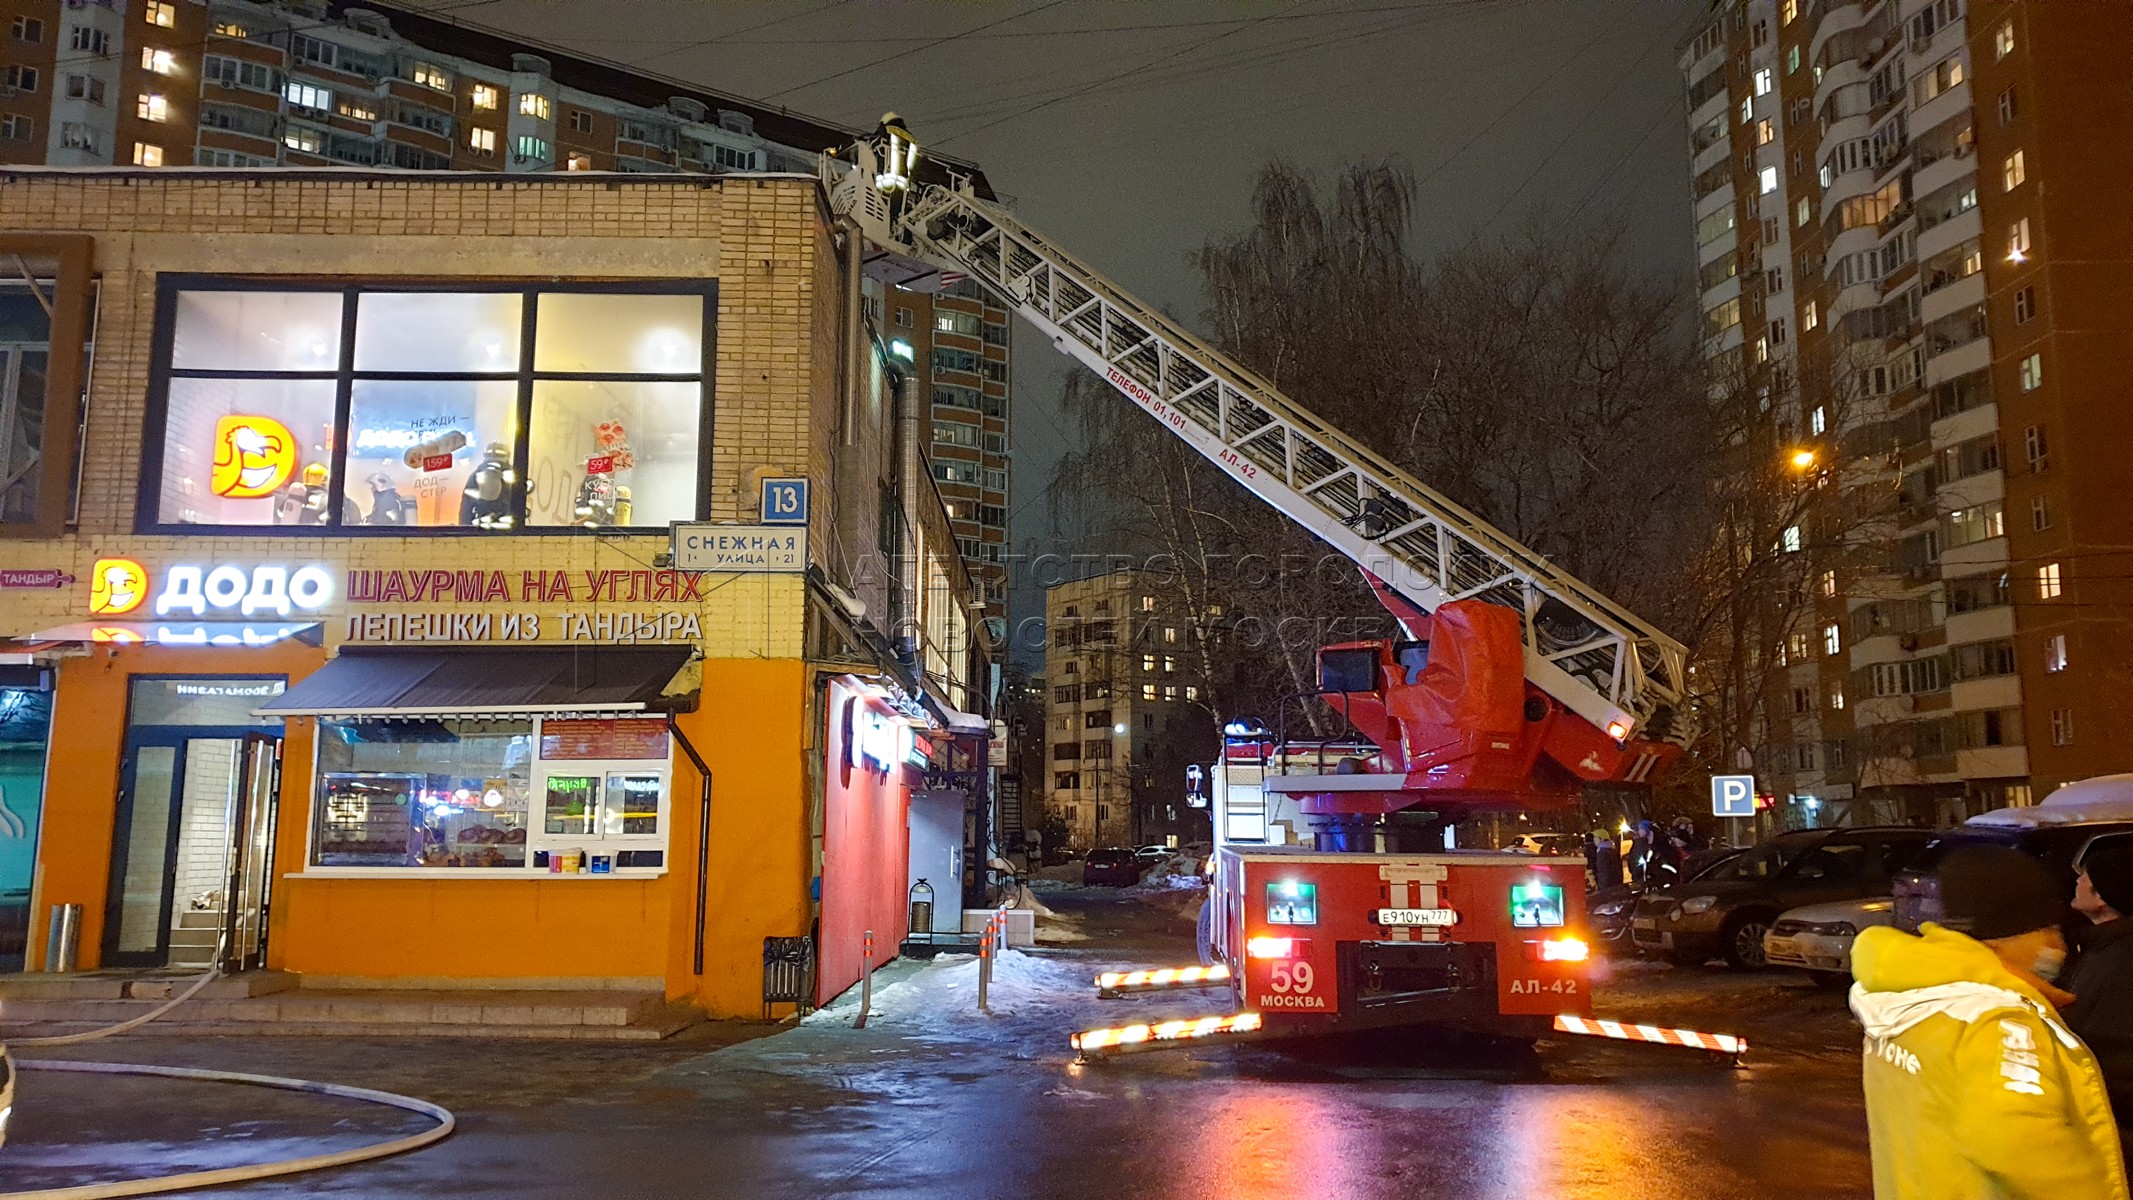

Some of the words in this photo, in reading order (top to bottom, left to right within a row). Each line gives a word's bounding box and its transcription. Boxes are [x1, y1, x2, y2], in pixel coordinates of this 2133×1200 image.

[1106, 366, 1152, 404] ТЕЛЕФОН
[1153, 401, 1187, 430] 01,101
[411, 419, 424, 429] НЕ
[428, 415, 456, 427] ЖДИ
[1219, 448, 1258, 479] АЛ-42
[421, 487, 447, 499] СТЕР
[773, 486, 798, 513] 13
[687, 535, 795, 550] СНЕЖНАЯ
[717, 554, 765, 564] УЛИЦА
[783, 554, 794, 563] 21
[3, 573, 55, 586] ТАНДЫР
[347, 569, 510, 602] ШАУРМА
[522, 569, 574, 602] НА
[585, 569, 704, 602] УГЛЯХ
[156, 565, 334, 616] ДОДО
[347, 612, 493, 642] ЛЕПЕШКИ
[500, 612, 541, 641] ИЗ
[557, 612, 703, 645] ТАНДЫРА
[1270, 961, 1314, 994] 59
[1510, 979, 1577, 994] АЛ-42
[1261, 994, 1325, 1008] МОСКВА
